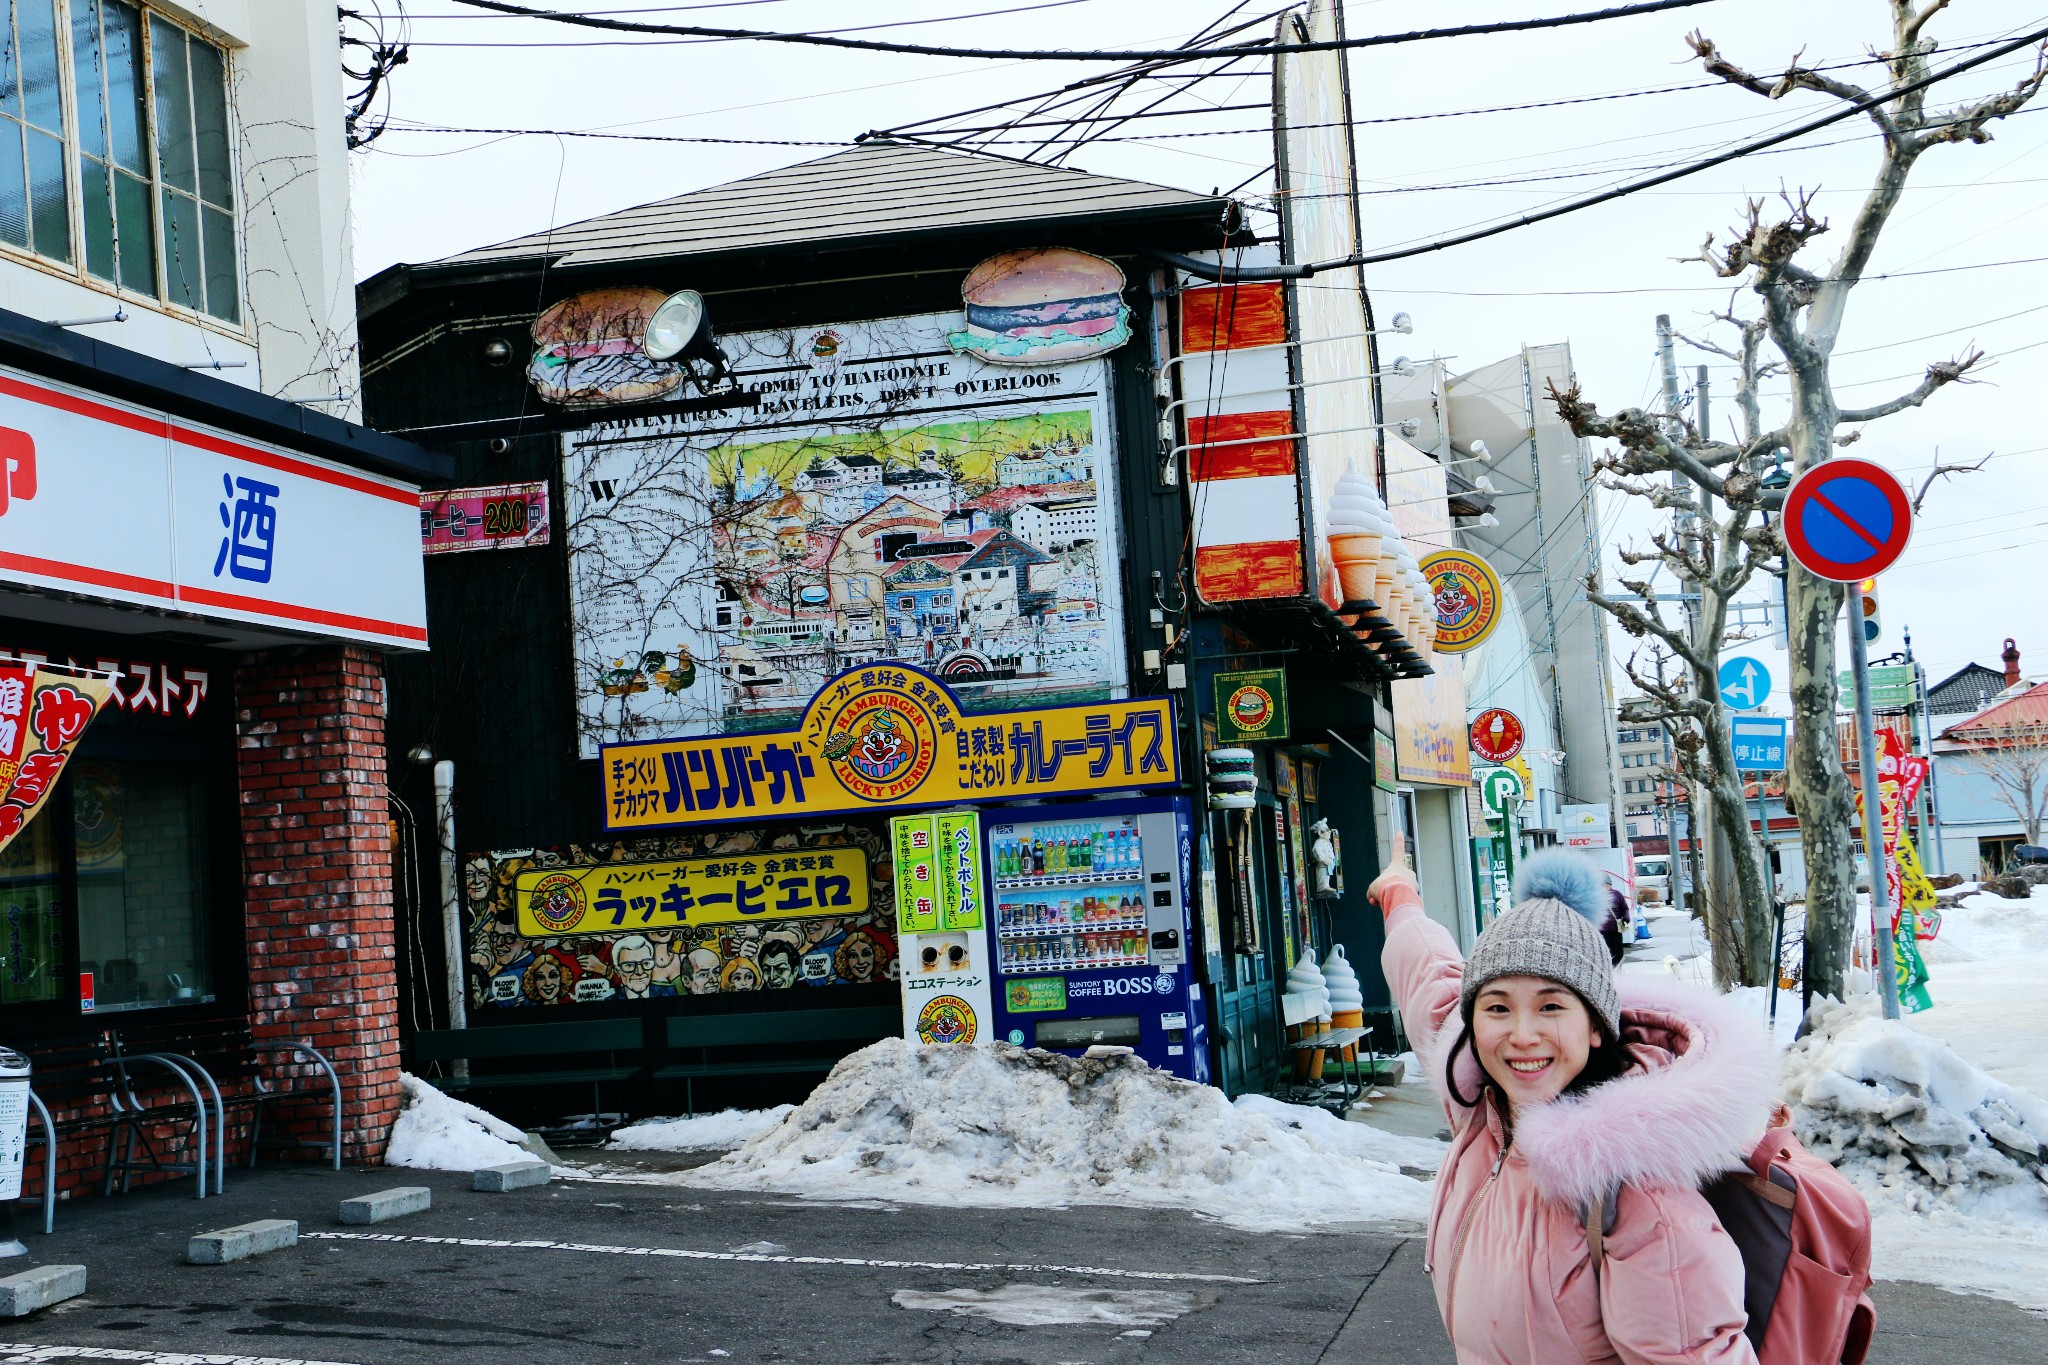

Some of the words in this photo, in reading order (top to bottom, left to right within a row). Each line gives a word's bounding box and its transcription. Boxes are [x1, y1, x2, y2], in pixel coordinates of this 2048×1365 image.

[810, 375, 836, 389] TO
[843, 362, 950, 386] HAKODATE
[954, 372, 1061, 396] OVERLOOK
[213, 472, 281, 584] 酒
[1461, 589, 1492, 639] PIERROT
[807, 670, 908, 748] ハンバーガー愛好会
[909, 681, 956, 735] 金賞受賞
[837, 694, 925, 730] HAMBURGER
[956, 724, 1005, 759] 自家製
[1008, 709, 1168, 785] カレーライス
[1472, 737, 1492, 758] LUCKY
[1493, 738, 1521, 759] PIERROT
[1734, 744, 1782, 763] 停止線
[612, 756, 657, 788] 手づくり
[661, 741, 815, 813] ハンバーガー
[838, 764, 885, 797] LUCKY
[889, 738, 932, 796] PIERROT
[958, 757, 1005, 789] こだわり
[613, 789, 660, 820] デカウマ
[1032, 822, 1103, 837] SUNTORY
[535, 875, 581, 895] HAMBURGER
[604, 861, 758, 885] ハンバーガー愛好会
[763, 854, 835, 874] 金賞受賞
[912, 831, 931, 913] 空き缶
[954, 826, 975, 913] ペットボトル
[536, 911, 561, 930] LUCKY
[562, 899, 585, 929] PIERROT
[592, 874, 852, 926] ラッキーピエロ
[908, 975, 982, 990] エコステーション
[1068, 980, 1101, 989] SUNTORY
[1068, 988, 1102, 997] COFFEE
[1102, 976, 1153, 997] BOSS
[923, 997, 972, 1017] HAMBURGER
